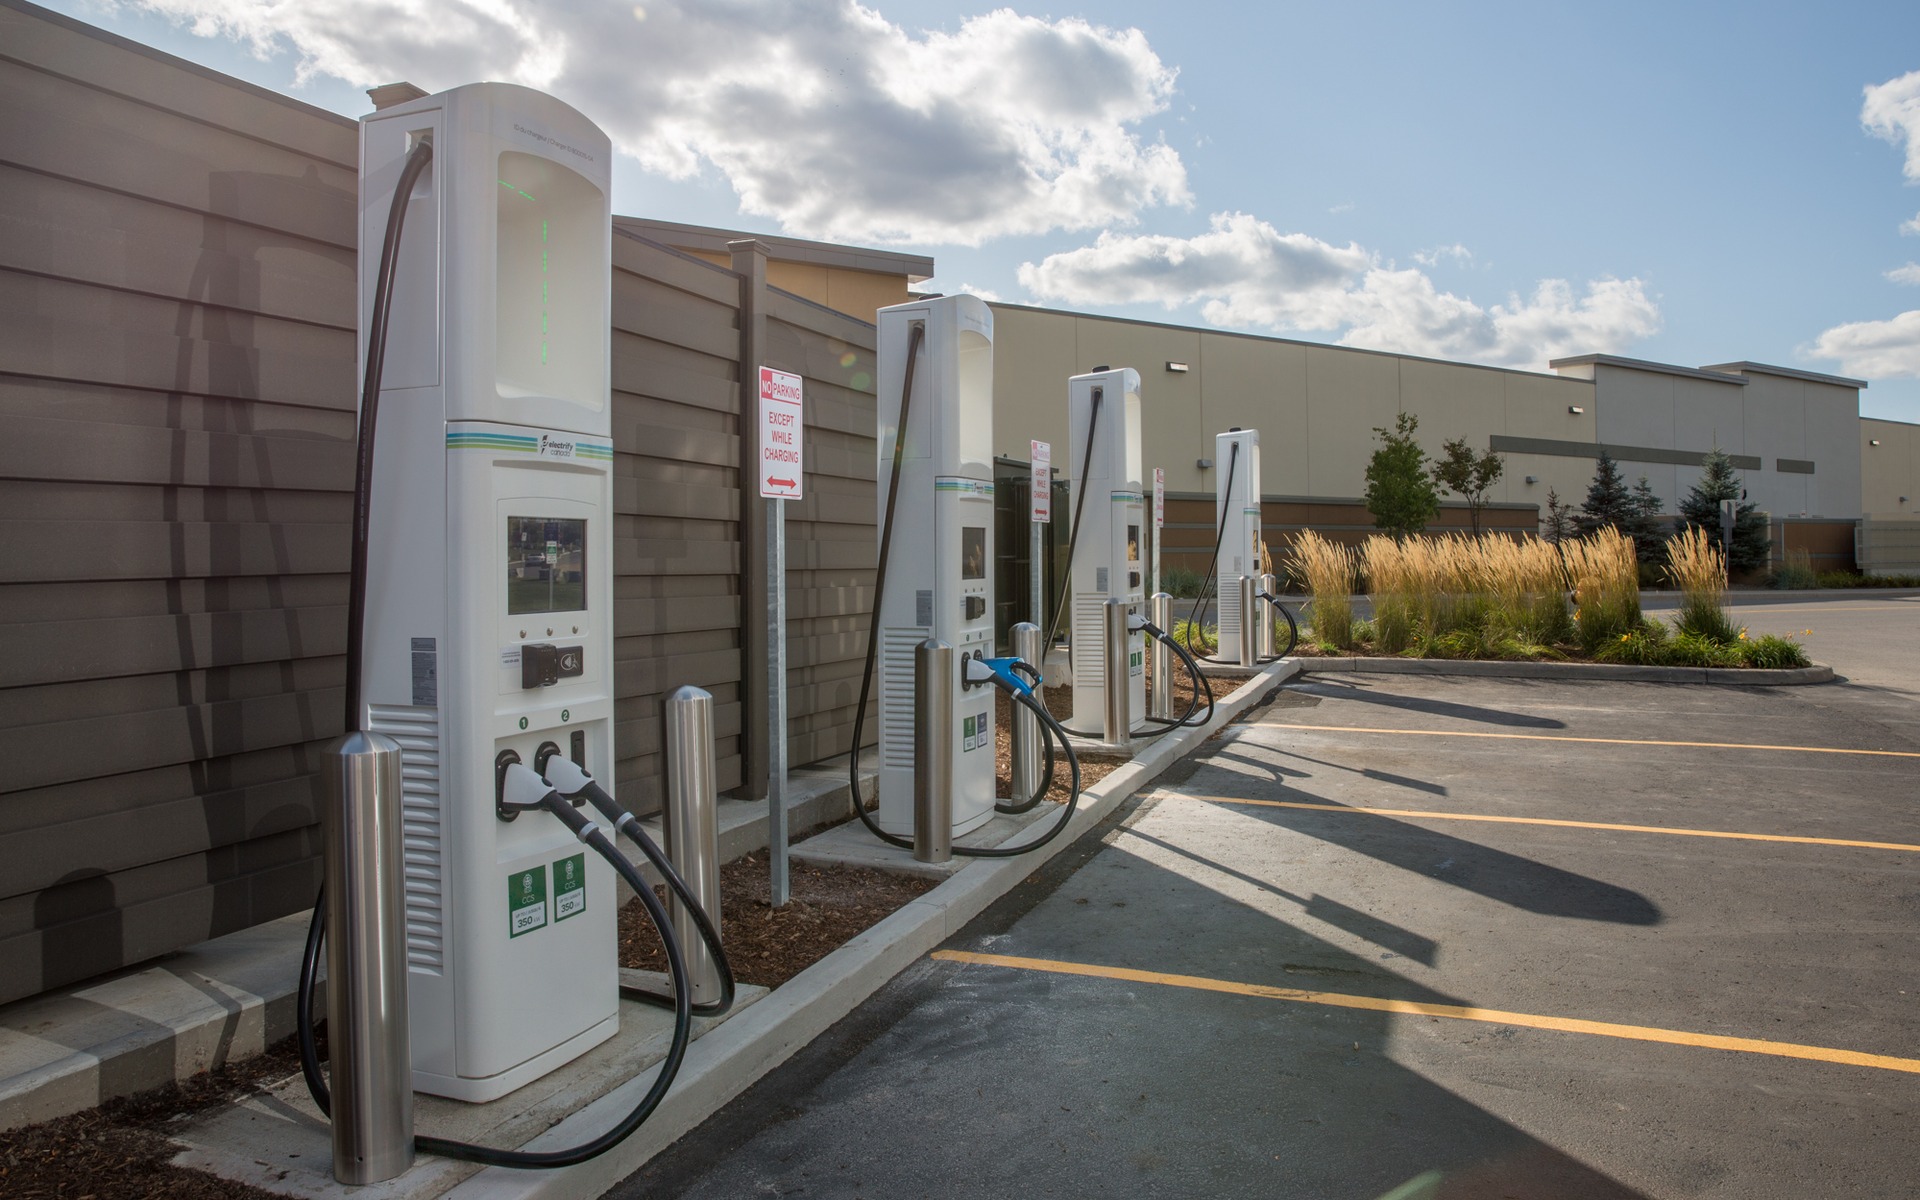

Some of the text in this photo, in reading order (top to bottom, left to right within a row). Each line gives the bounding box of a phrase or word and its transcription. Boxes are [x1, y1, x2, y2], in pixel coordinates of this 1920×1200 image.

[762, 379, 800, 400] NO PARKING
[769, 411, 795, 427] EXCEPT
[771, 430, 792, 445] WHILE
[549, 441, 573, 452] electrify
[764, 447, 798, 463] CHARGING
[565, 880, 576, 890] CCS
[522, 893, 535, 904] CCS
[561, 901, 574, 913] 350
[517, 915, 533, 928] 350
